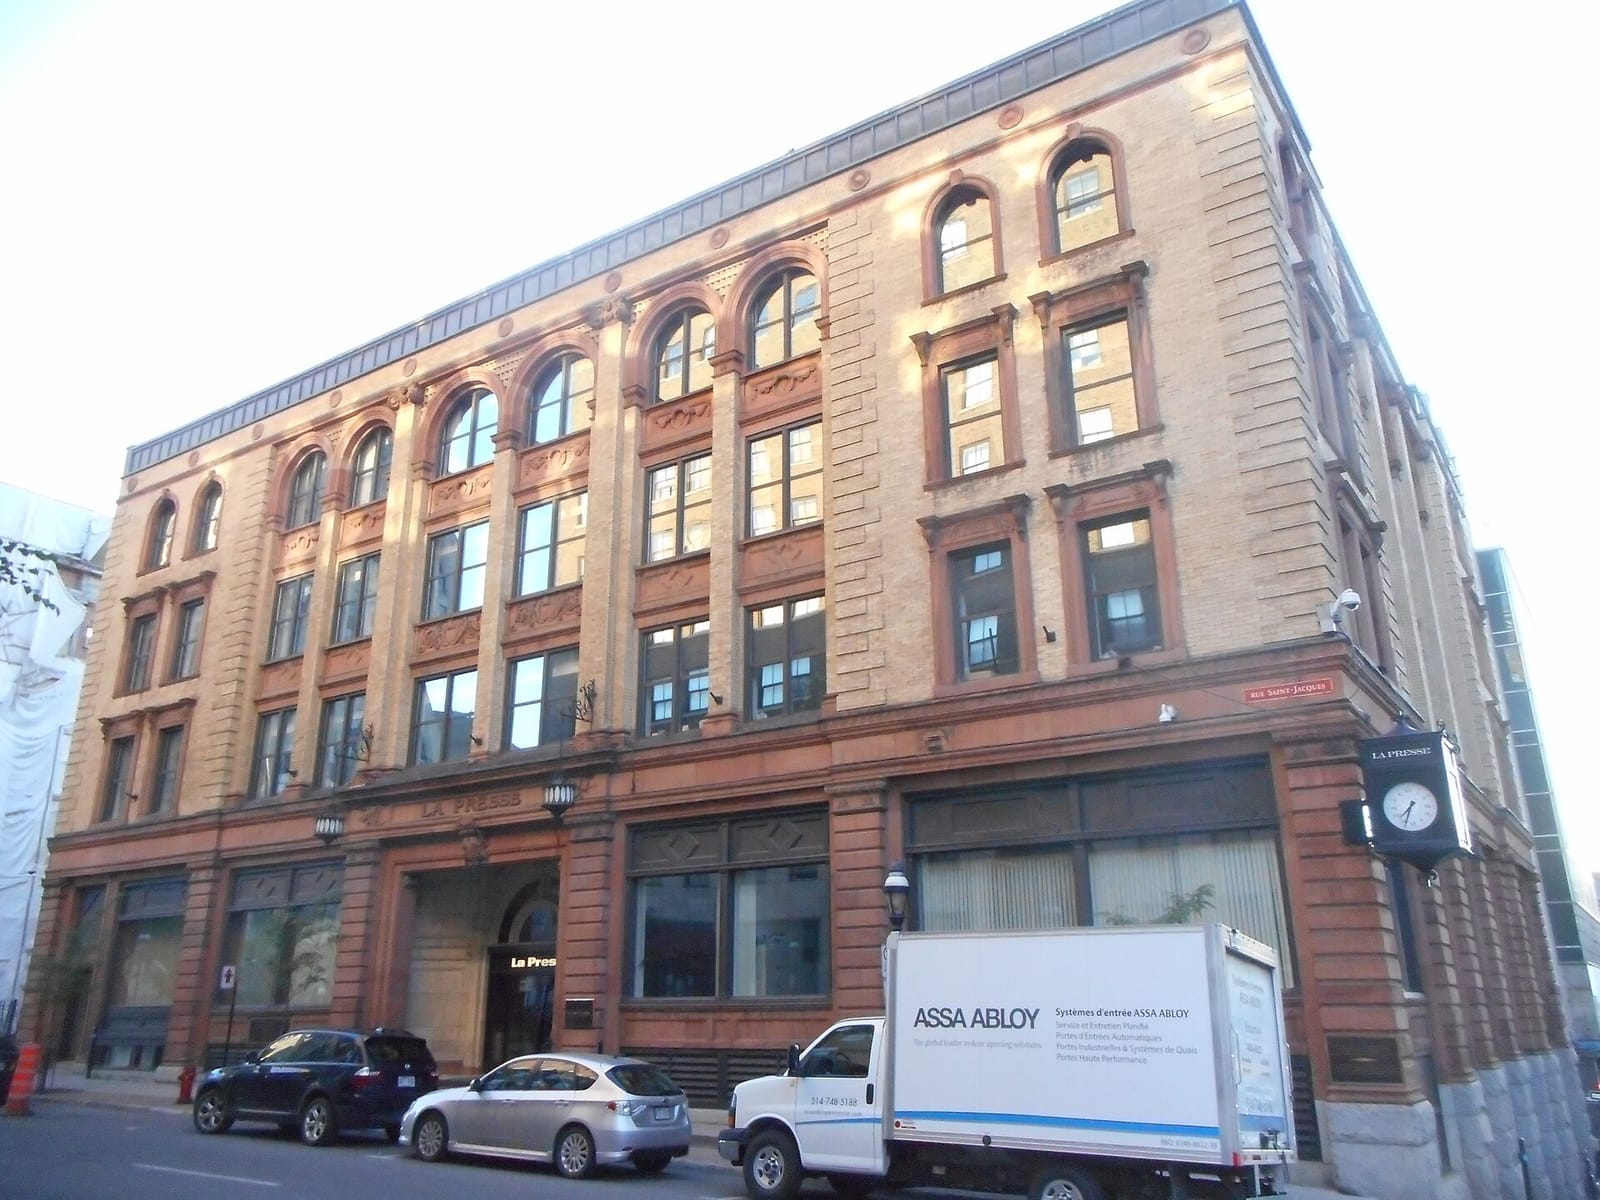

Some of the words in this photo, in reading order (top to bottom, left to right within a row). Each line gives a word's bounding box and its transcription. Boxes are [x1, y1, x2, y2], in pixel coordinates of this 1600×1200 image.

[1372, 752, 1386, 760] LA
[1387, 747, 1432, 759] PRESSE
[422, 803, 445, 818] LA
[454, 791, 522, 815] PRESSE
[511, 957, 526, 968] La
[527, 956, 557, 968] Pres
[913, 1007, 967, 1029] ASSA
[970, 1007, 1040, 1030] ABLOY
[1055, 1007, 1095, 1018] Systèmes
[1133, 1008, 1158, 1018] ASSA
[1158, 1009, 1190, 1019] ABLOY
[1055, 1021, 1081, 1030] Service
[1081, 1022, 1089, 1030] et
[1090, 1022, 1122, 1031] Entretien
[1055, 1032, 1078, 1040] Portes
[1111, 1033, 1163, 1042] Automatiques
[1056, 1043, 1078, 1051] Portes
[1165, 1045, 1175, 1053] de
[1176, 1046, 1198, 1055] Quais
[1056, 1053, 1078, 1061] Portes
[1079, 1054, 1101, 1062] Haute
[1101, 1055, 1148, 1064] Performance
